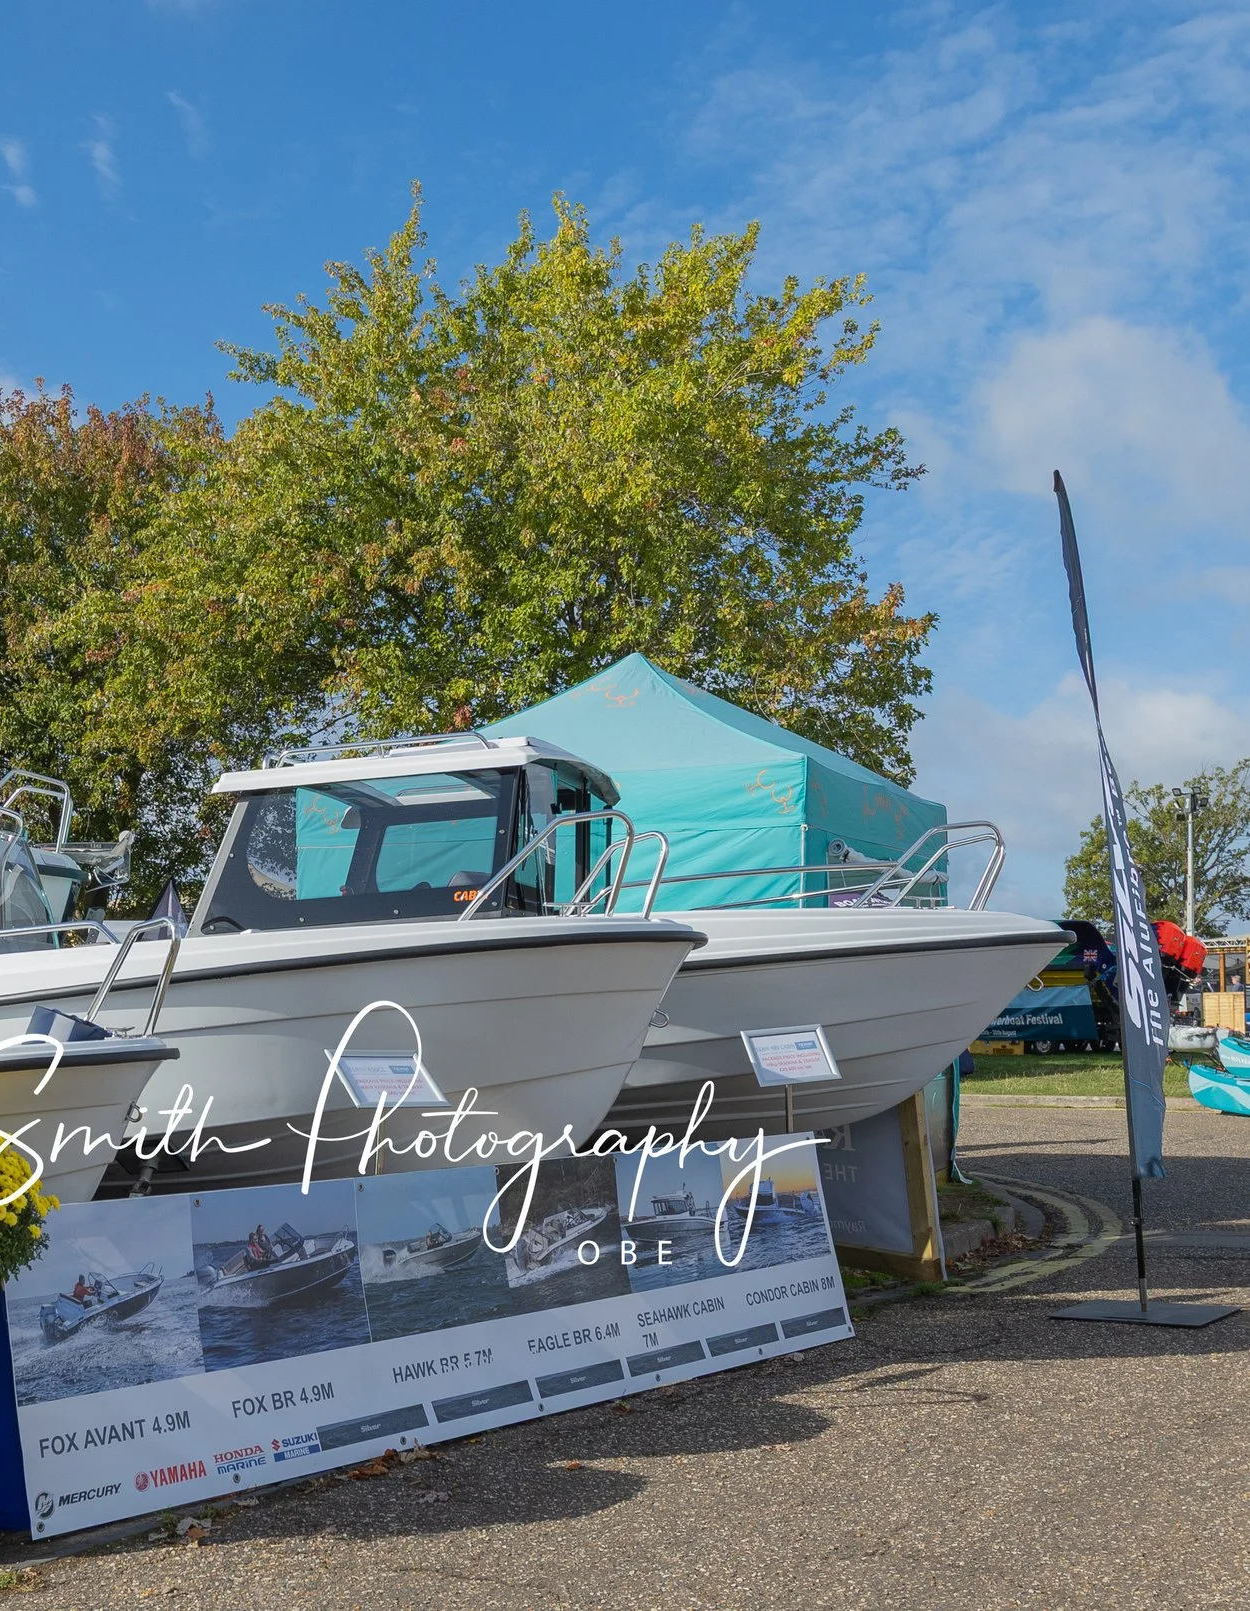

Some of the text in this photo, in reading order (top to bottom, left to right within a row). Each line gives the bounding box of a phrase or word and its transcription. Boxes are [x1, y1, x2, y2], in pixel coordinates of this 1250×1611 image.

[454, 890, 488, 901] CAB
[1026, 1013, 1064, 1025] Festival
[746, 1276, 836, 1306] CONDOR CABIN 8M
[637, 1296, 726, 1327] SEAHAWK CABIN
[527, 1322, 621, 1355] EAGLE BR 6.4M
[642, 1332, 659, 1348] 7M
[392, 1360, 438, 1383] HAWK
[232, 1382, 335, 1419] FOX BR 4.9M
[39, 1410, 191, 1458] FOX AVANT 4.9M
[360, 1422, 382, 1434] Silver
[281, 1432, 319, 1449] SUZUKI
[214, 1444, 264, 1464] HONDA
[283, 1446, 311, 1460] MARINE
[150, 1460, 207, 1488] YAMAHA
[58, 1482, 122, 1508] MERCURY
